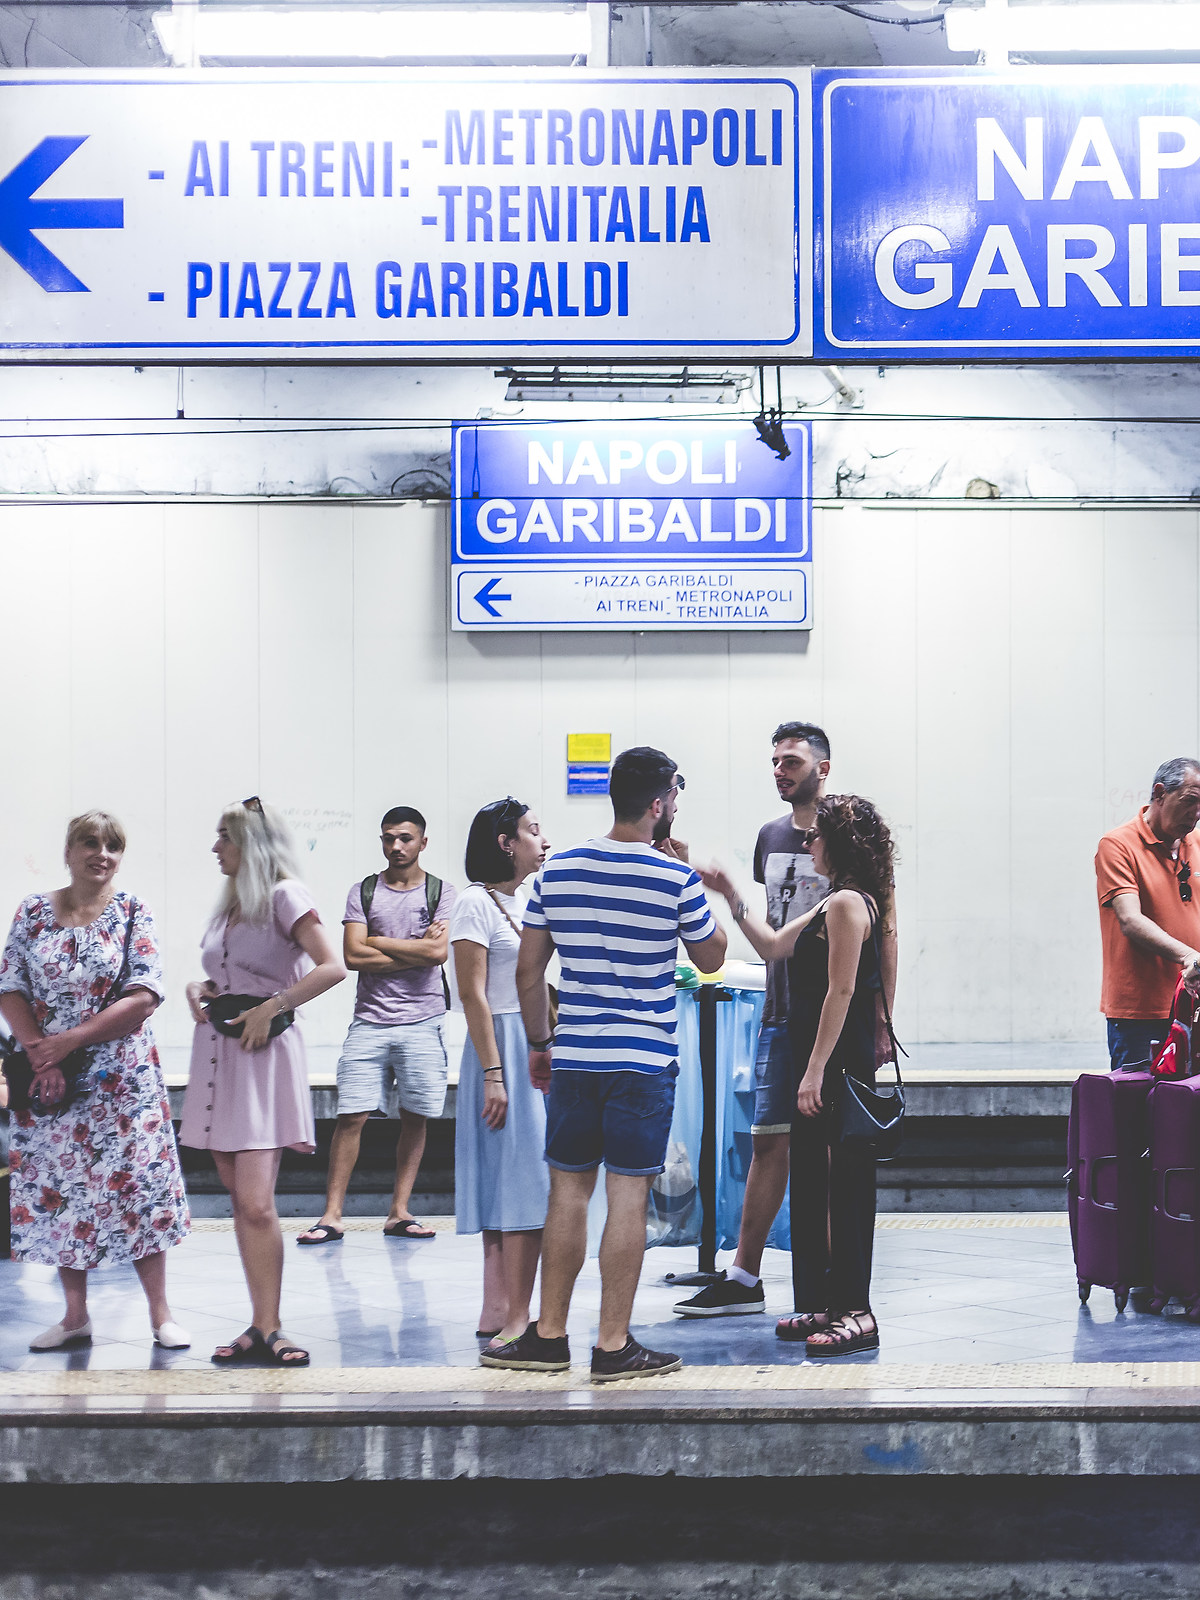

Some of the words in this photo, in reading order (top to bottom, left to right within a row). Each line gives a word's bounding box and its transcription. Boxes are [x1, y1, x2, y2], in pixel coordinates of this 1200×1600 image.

[183, 140, 232, 198] AI
[250, 141, 410, 198] TRENI:
[187, 261, 356, 319] PIAZZA
[375, 260, 630, 319] GARIBALDI
[526, 439, 738, 486] NAPOLI
[475, 497, 788, 544] GARIBALDI
[584, 575, 641, 588] PIAZZA
[645, 574, 734, 588] GARIBALDI
[675, 589, 793, 602] METRONAPOLI
[596, 600, 612, 612] AI
[616, 600, 664, 612] TRENI
[677, 605, 769, 618] TRENITALIA
